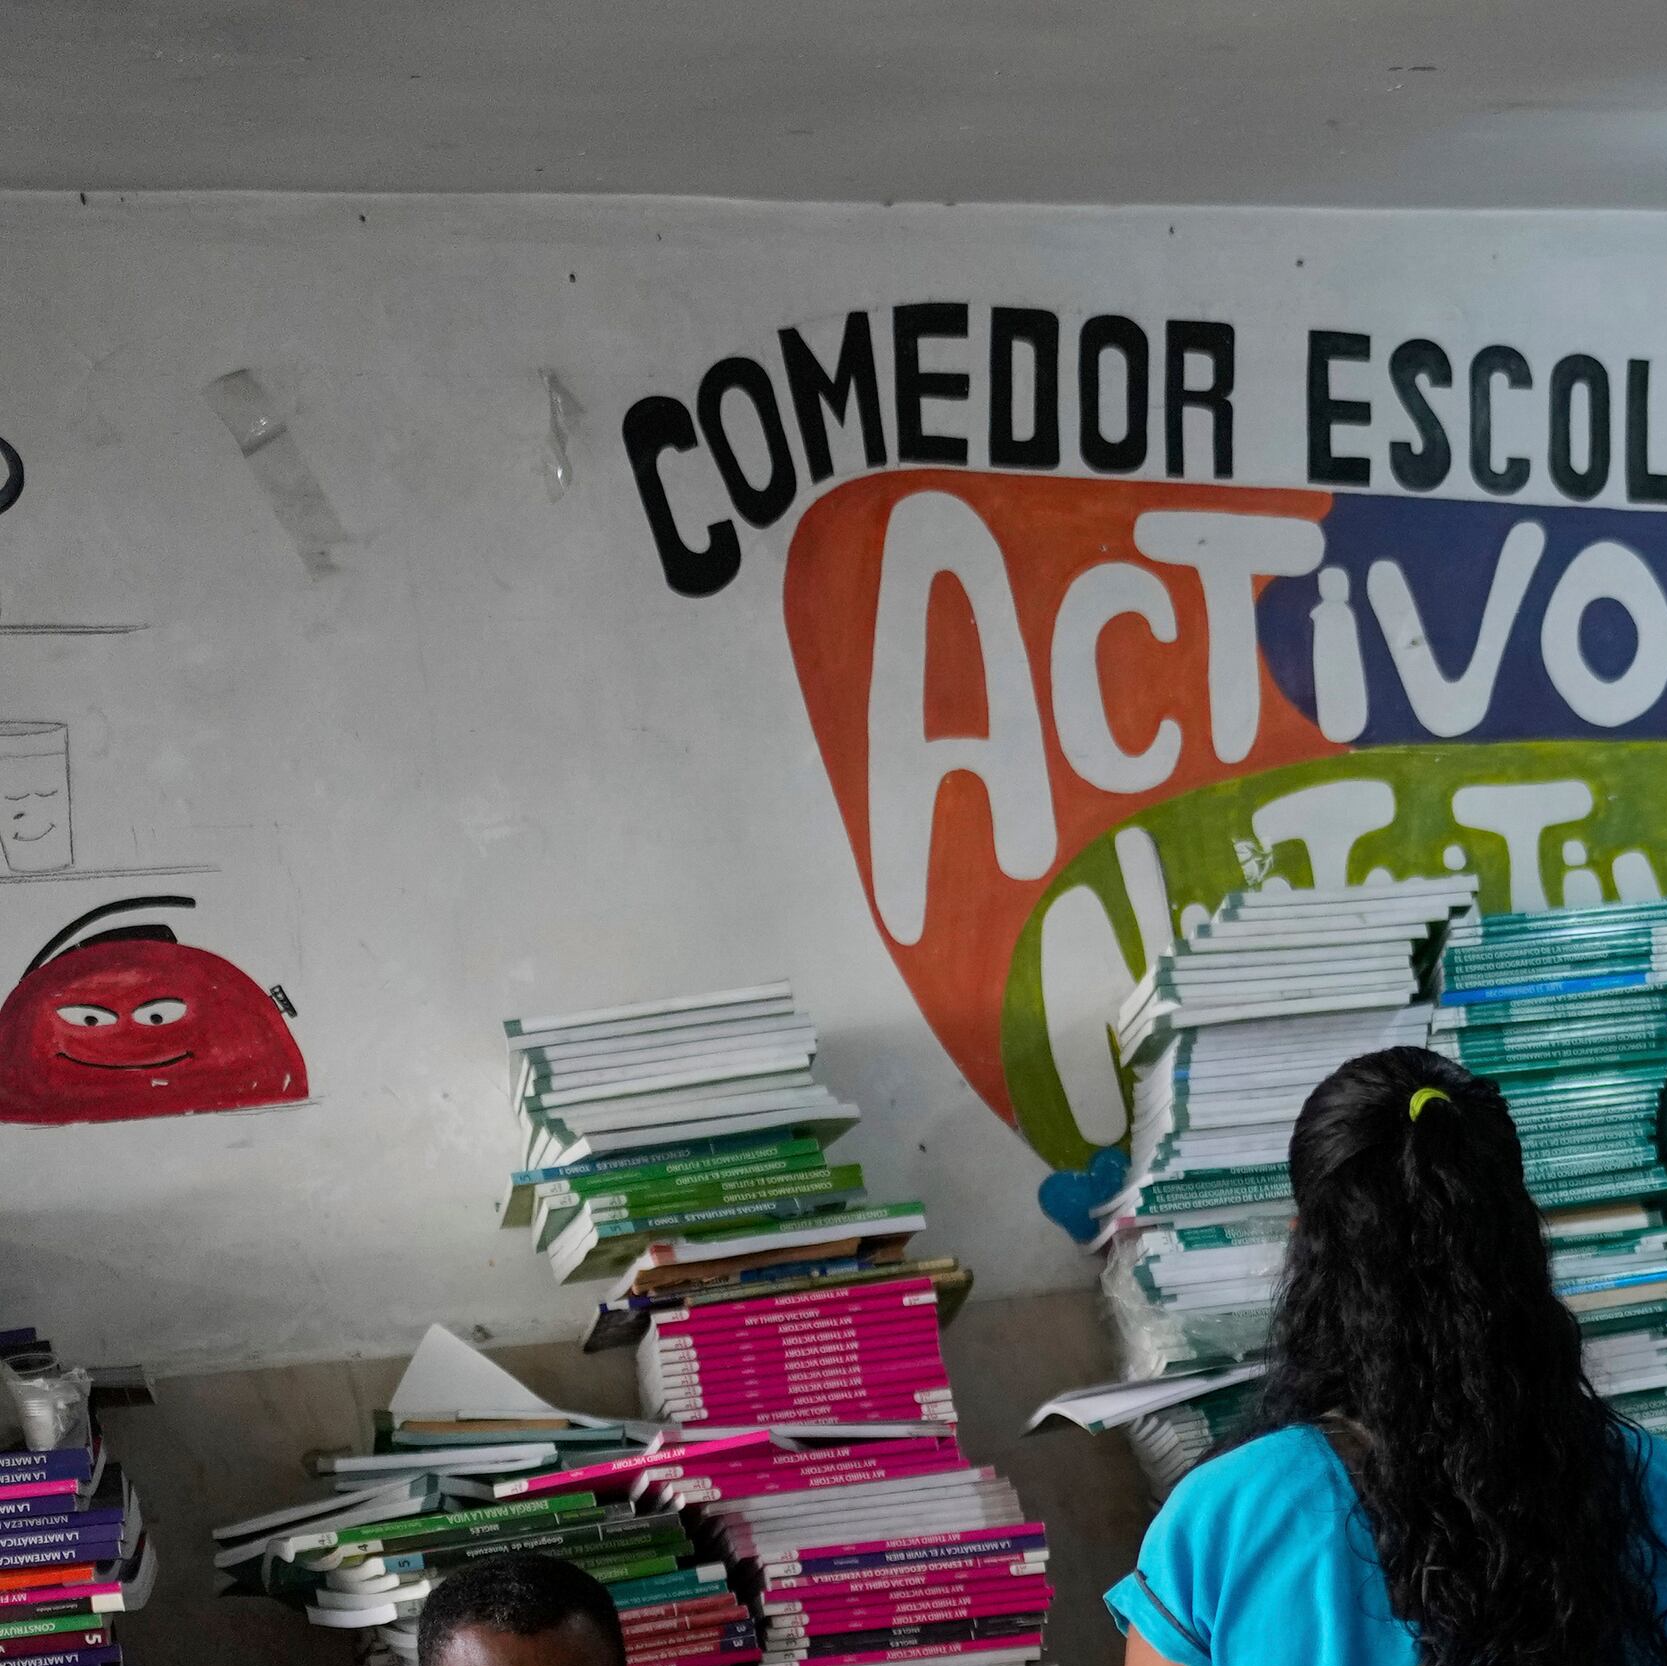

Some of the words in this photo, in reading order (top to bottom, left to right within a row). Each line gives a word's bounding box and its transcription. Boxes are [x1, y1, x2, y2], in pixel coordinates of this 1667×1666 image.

[622, 302, 1234, 598] COMEDOR
[66, 1532, 79, 1541] LA
[85, 1635, 101, 1644] 5
